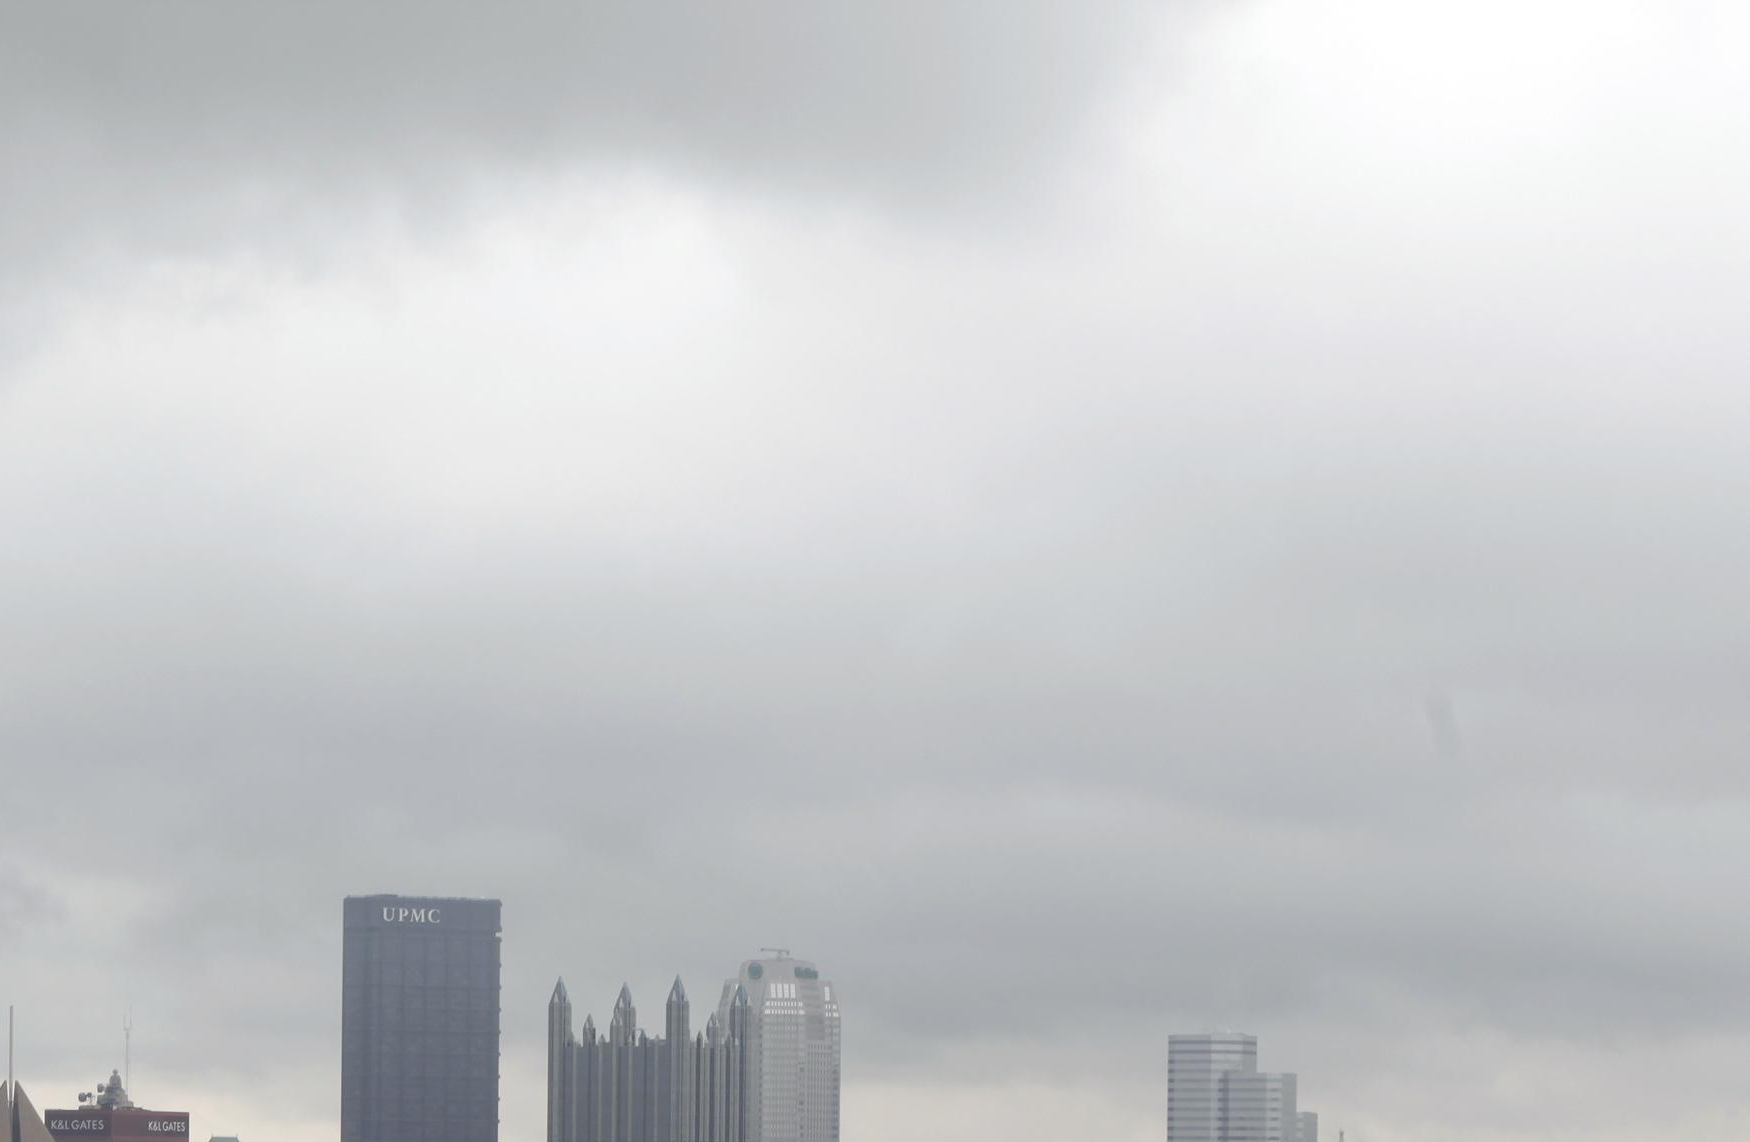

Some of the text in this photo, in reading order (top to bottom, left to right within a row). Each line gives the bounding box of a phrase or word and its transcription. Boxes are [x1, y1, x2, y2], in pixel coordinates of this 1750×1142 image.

[382, 907, 440, 923] UPMC
[51, 1120, 104, 1130] K&L GATES
[148, 1121, 186, 1132] K&L GATES
